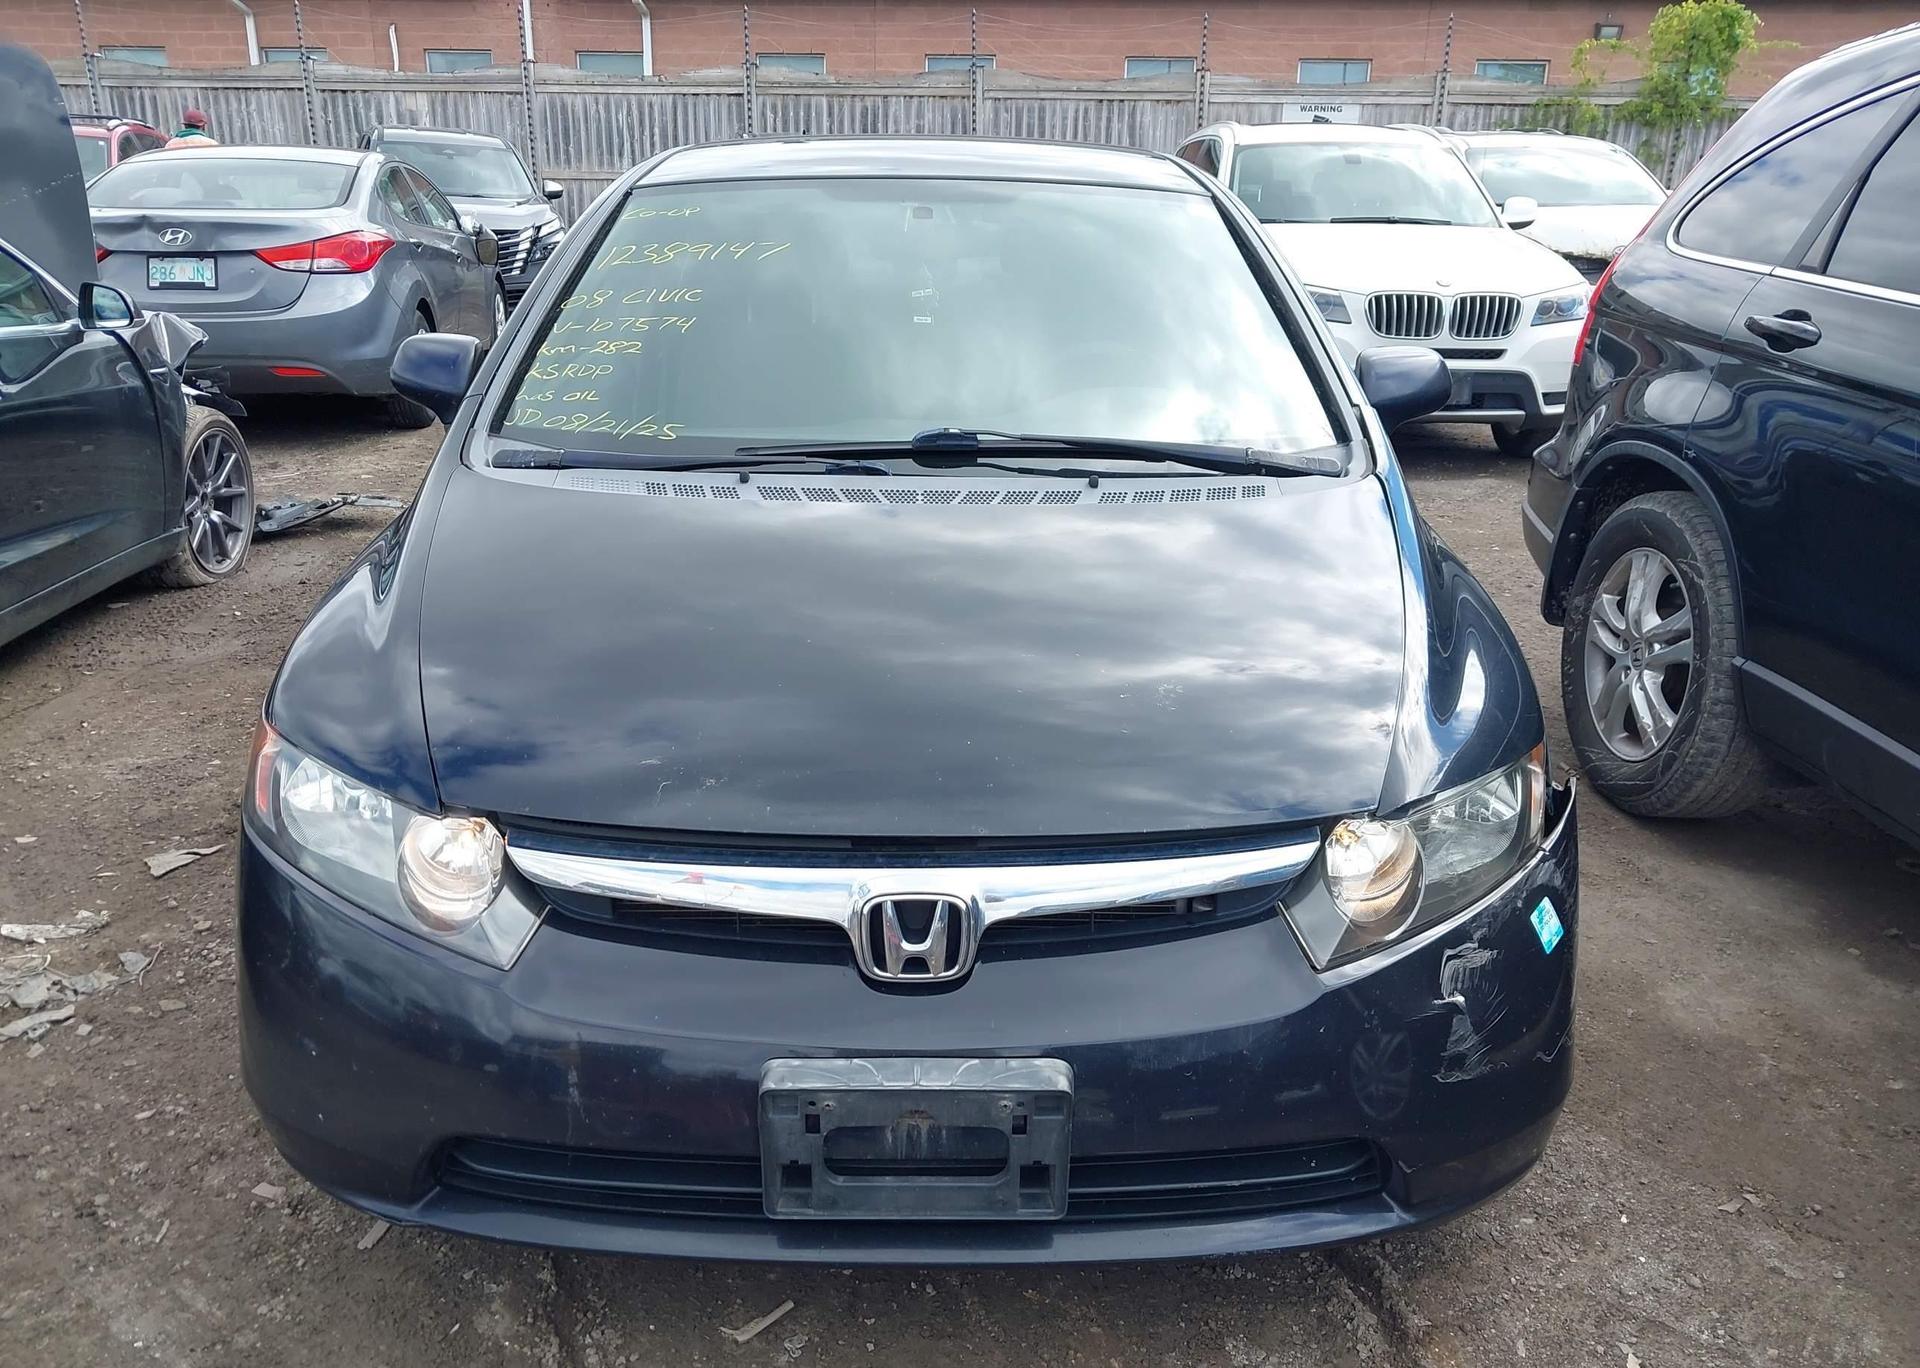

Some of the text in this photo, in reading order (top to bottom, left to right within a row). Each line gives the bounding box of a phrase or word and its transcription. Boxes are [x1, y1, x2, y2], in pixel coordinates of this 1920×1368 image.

[597, 241, 791, 271] 12389147
[151, 265, 213, 280] 286 JNJ
[560, 288, 703, 309] 08 CIVIC
[562, 390, 600, 401] OIL
